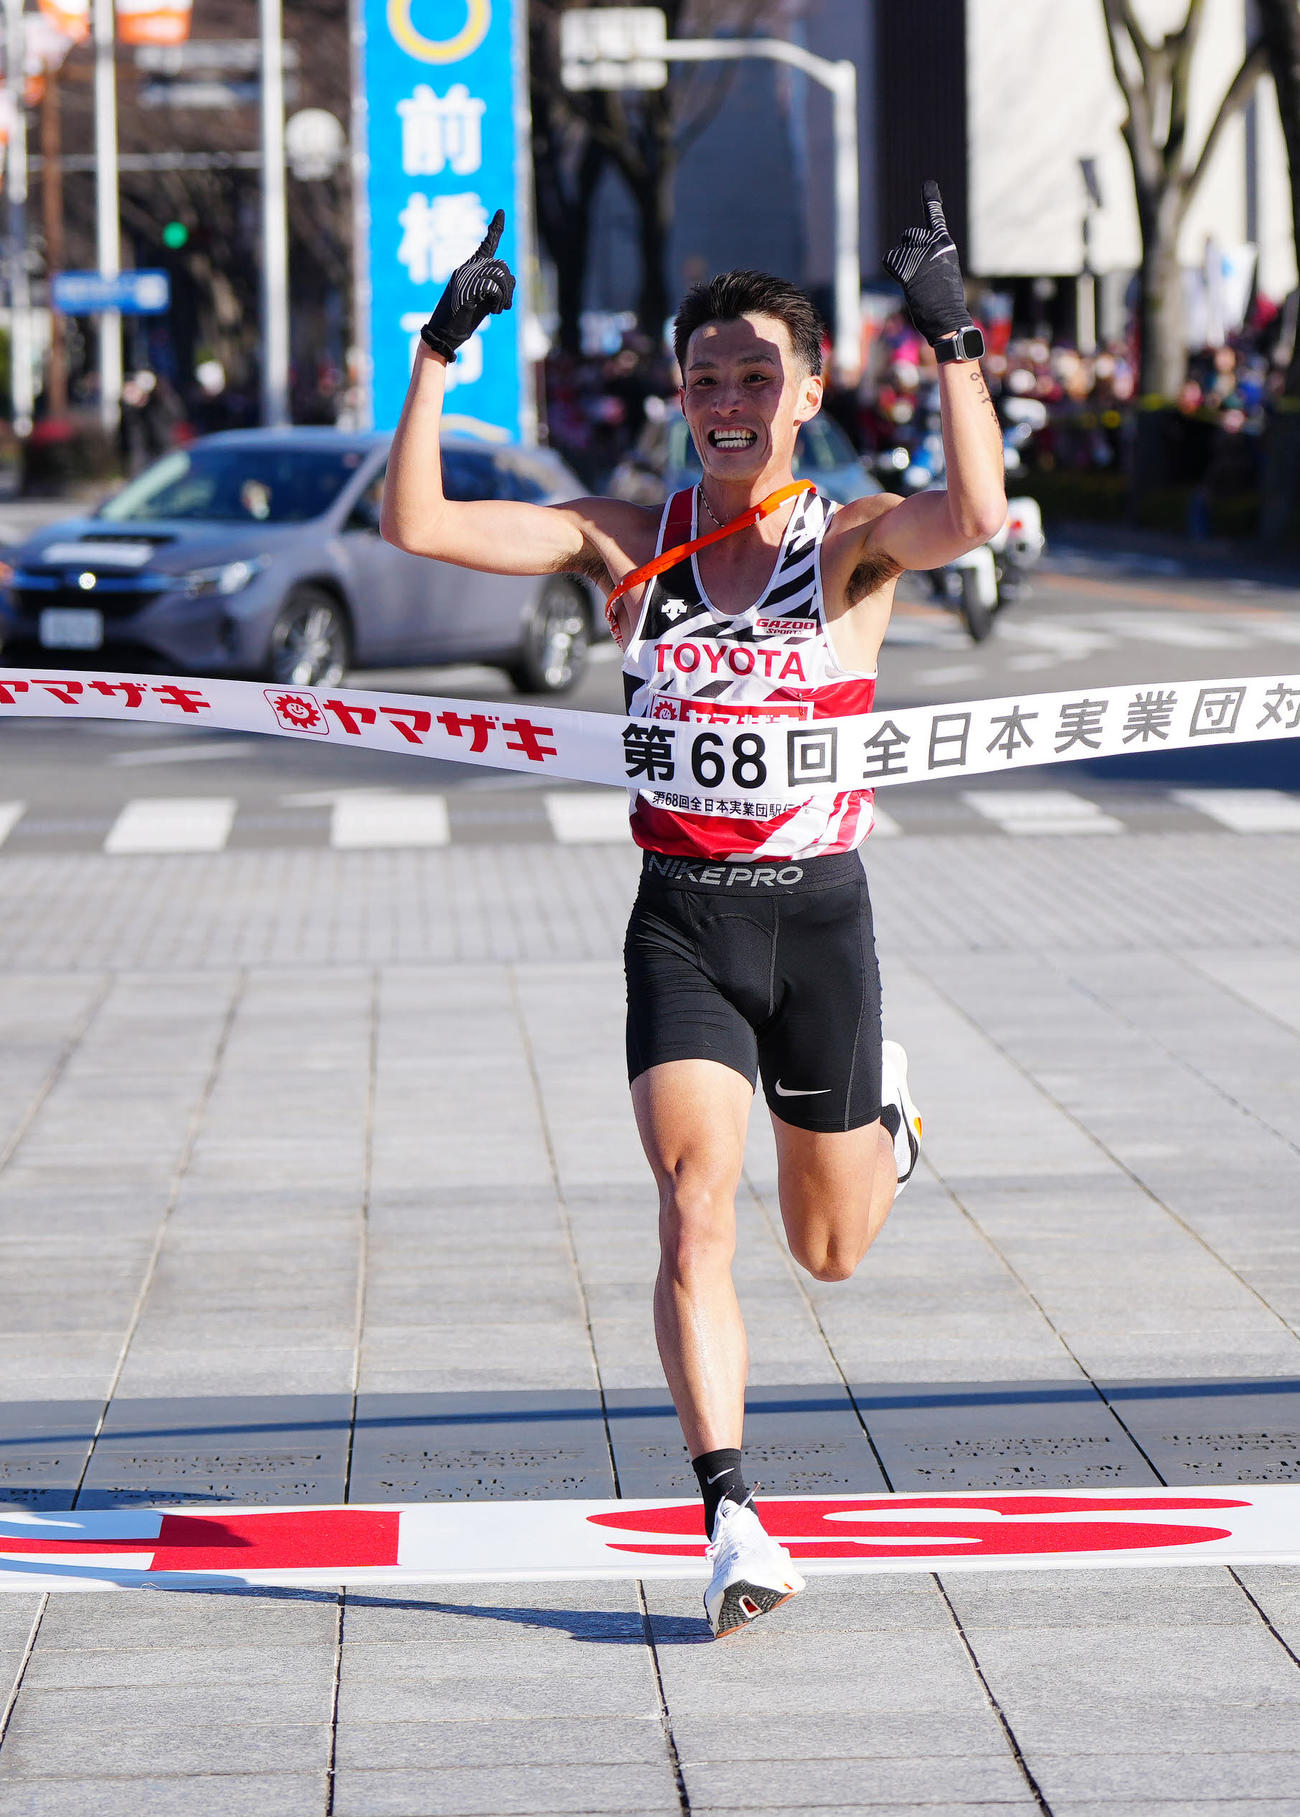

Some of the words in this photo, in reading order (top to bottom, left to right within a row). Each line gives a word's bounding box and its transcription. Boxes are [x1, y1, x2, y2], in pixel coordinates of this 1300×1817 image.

[755, 618, 815, 630] GAZOO
[654, 642, 807, 682] TOYOTA
[324, 698, 558, 762] ヤマザキ
[648, 854, 726, 886] NIKE
[726, 866, 804, 888] PRO
